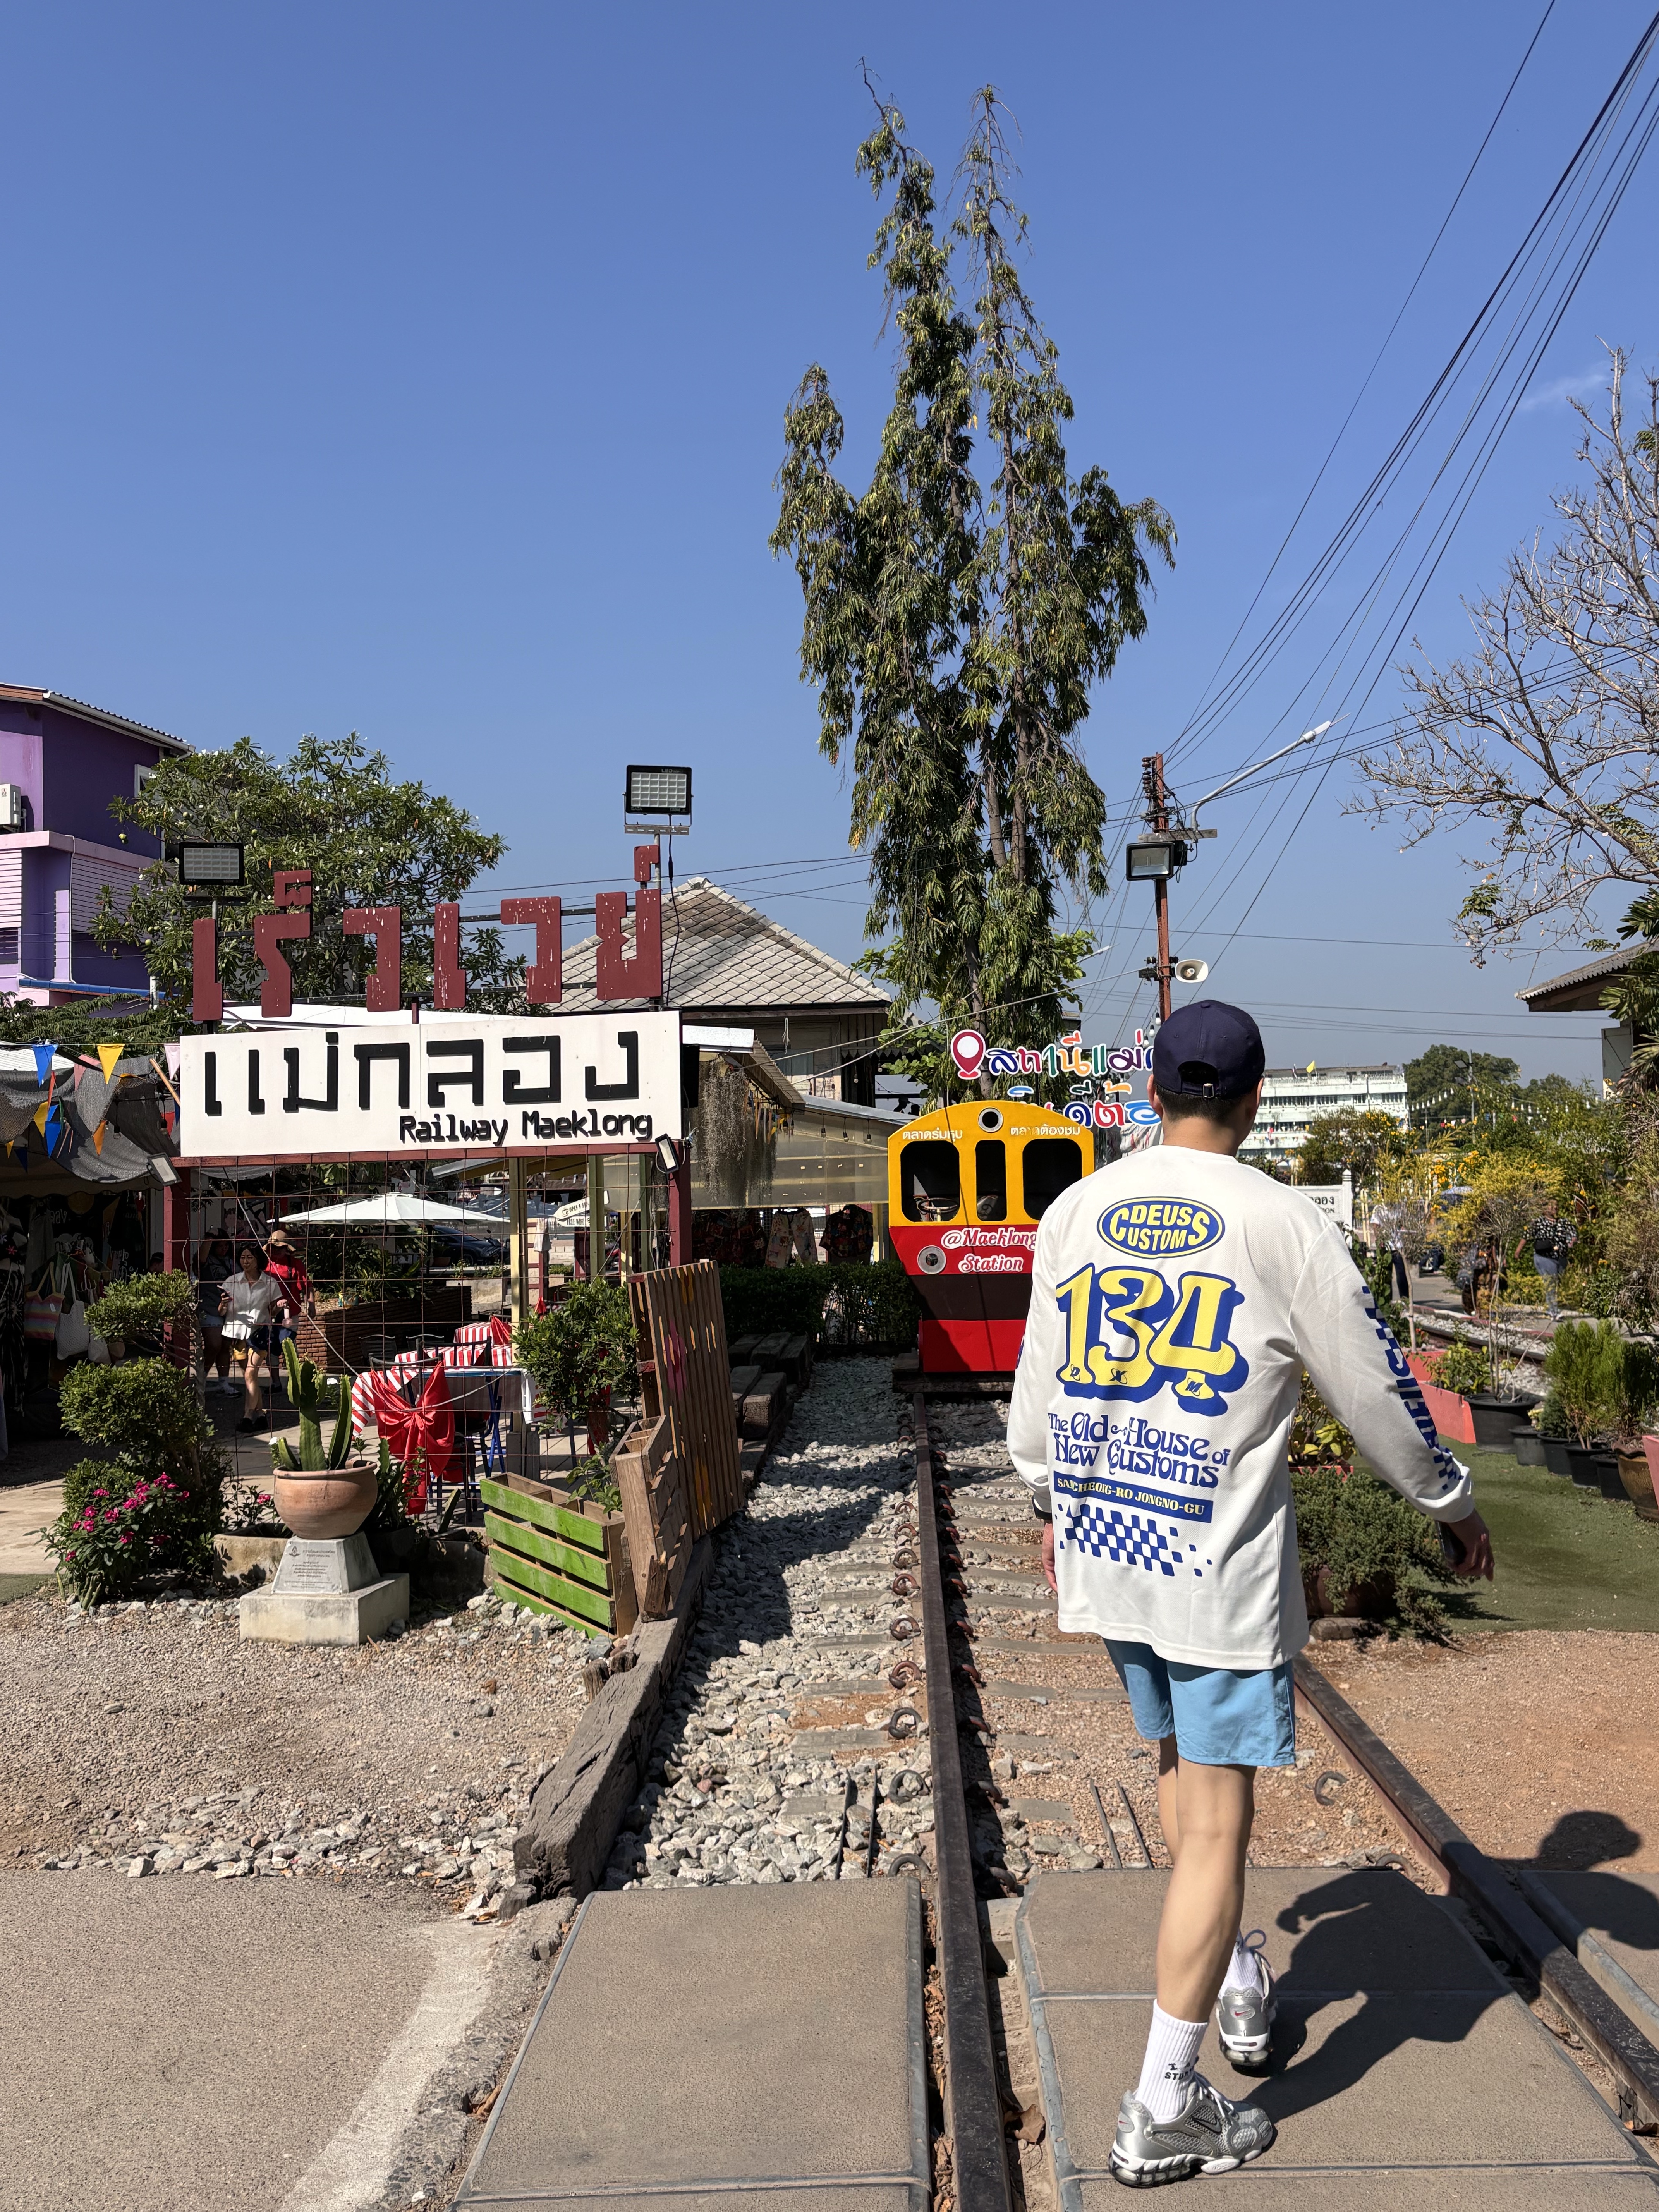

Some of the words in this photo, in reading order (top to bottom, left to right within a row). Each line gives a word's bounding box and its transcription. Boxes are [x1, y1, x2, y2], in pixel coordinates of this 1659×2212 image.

[205, 1031, 638, 1116] แม่กลอง
[400, 1114, 508, 1146] Railway
[522, 1109, 653, 1143] Maeklong
[903, 1127, 963, 1142] ตลาดร่มหุบ
[958, 1254, 1024, 1273] Station
[1056, 1262, 1249, 1416] 134
[1048, 1413, 1068, 1431] The
[1070, 1412, 1109, 1443] Old
[1111, 1417, 1210, 1461] House
[1212, 1449, 1231, 1465] of
[1053, 1432, 1100, 1466] New
[1107, 1439, 1219, 1488] Customs
[1135, 1491, 1205, 1515] JONGNO-GU
